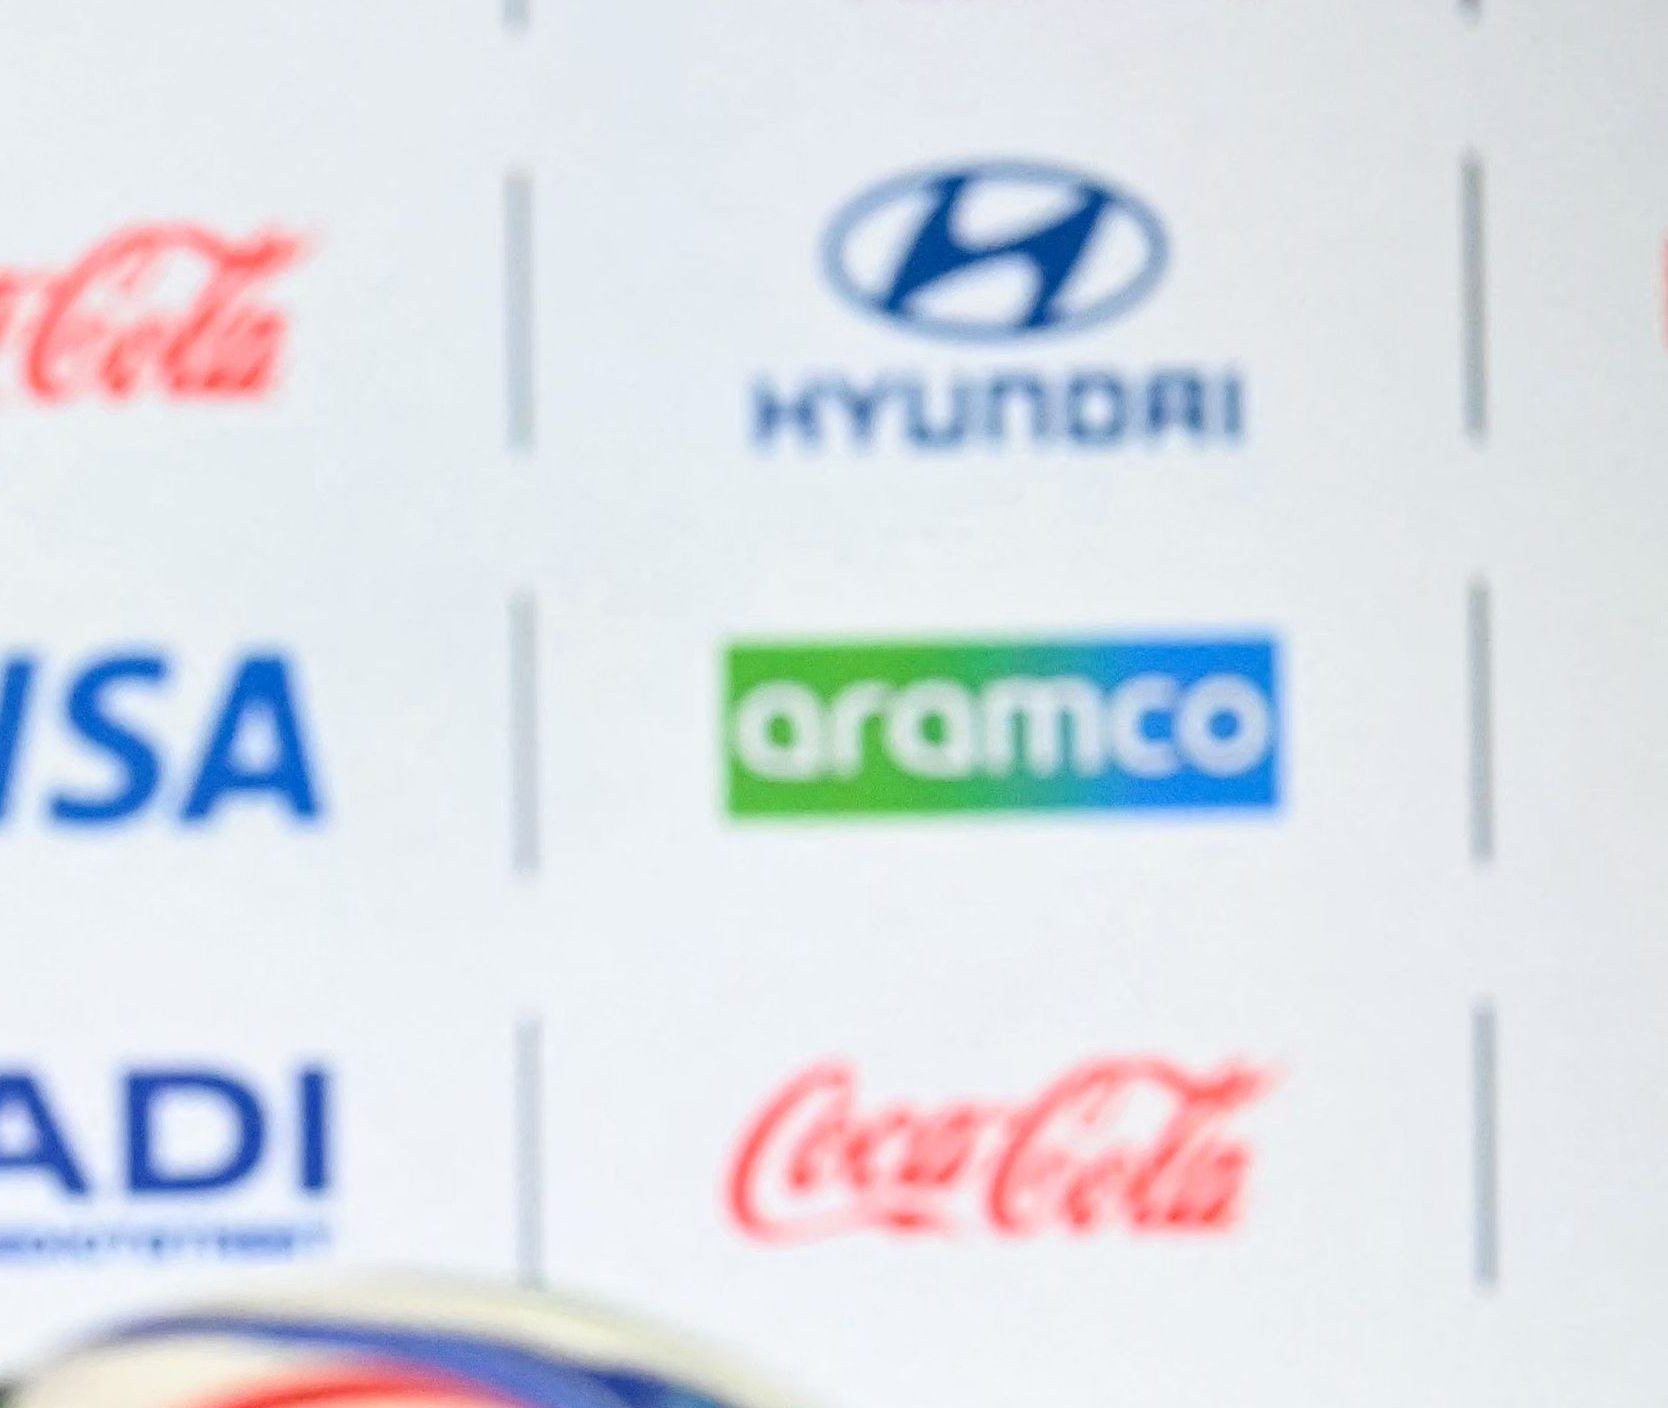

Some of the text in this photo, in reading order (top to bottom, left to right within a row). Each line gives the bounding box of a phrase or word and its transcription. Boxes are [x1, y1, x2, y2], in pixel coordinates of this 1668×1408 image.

[750, 366, 1246, 453] HYUNDAI
[734, 674, 1273, 780] aramco
[722, 1057, 1279, 1242] Coca-Cola
